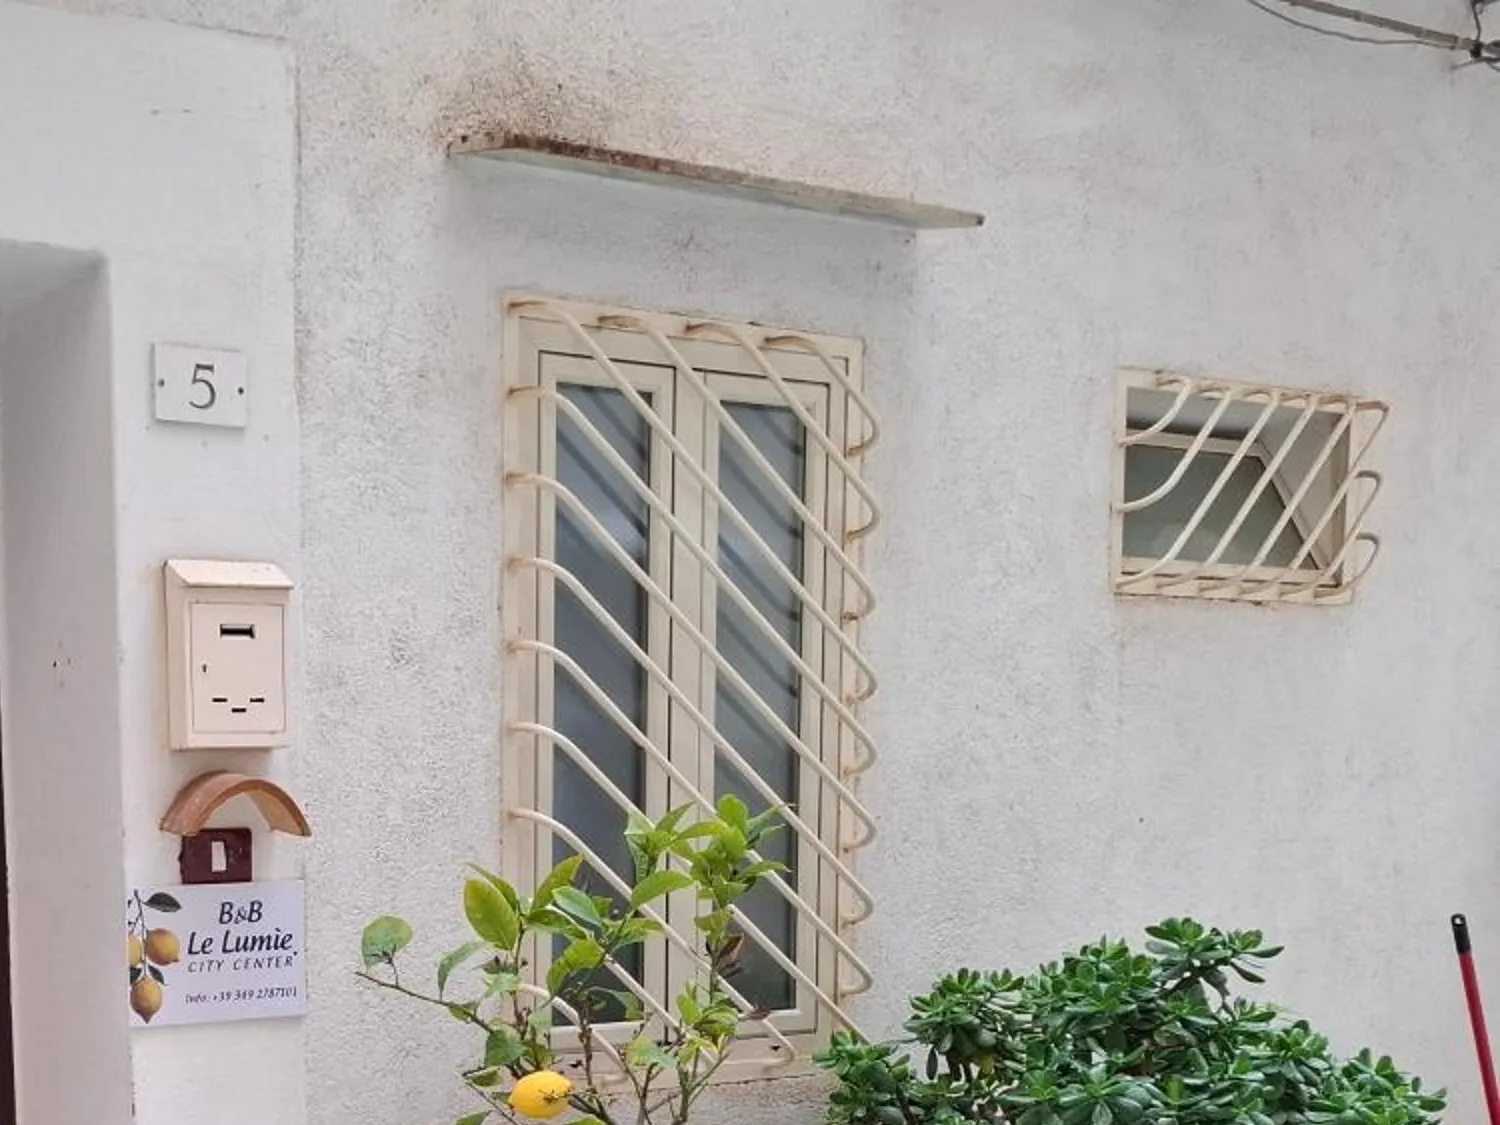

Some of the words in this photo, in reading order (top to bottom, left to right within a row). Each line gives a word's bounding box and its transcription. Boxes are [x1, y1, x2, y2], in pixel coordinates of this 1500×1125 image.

[189, 363, 216, 409] 5
[219, 900, 263, 925] B&B
[187, 931, 213, 955] Le
[187, 960, 225, 973] CITY
[233, 956, 294, 971] CENTER
